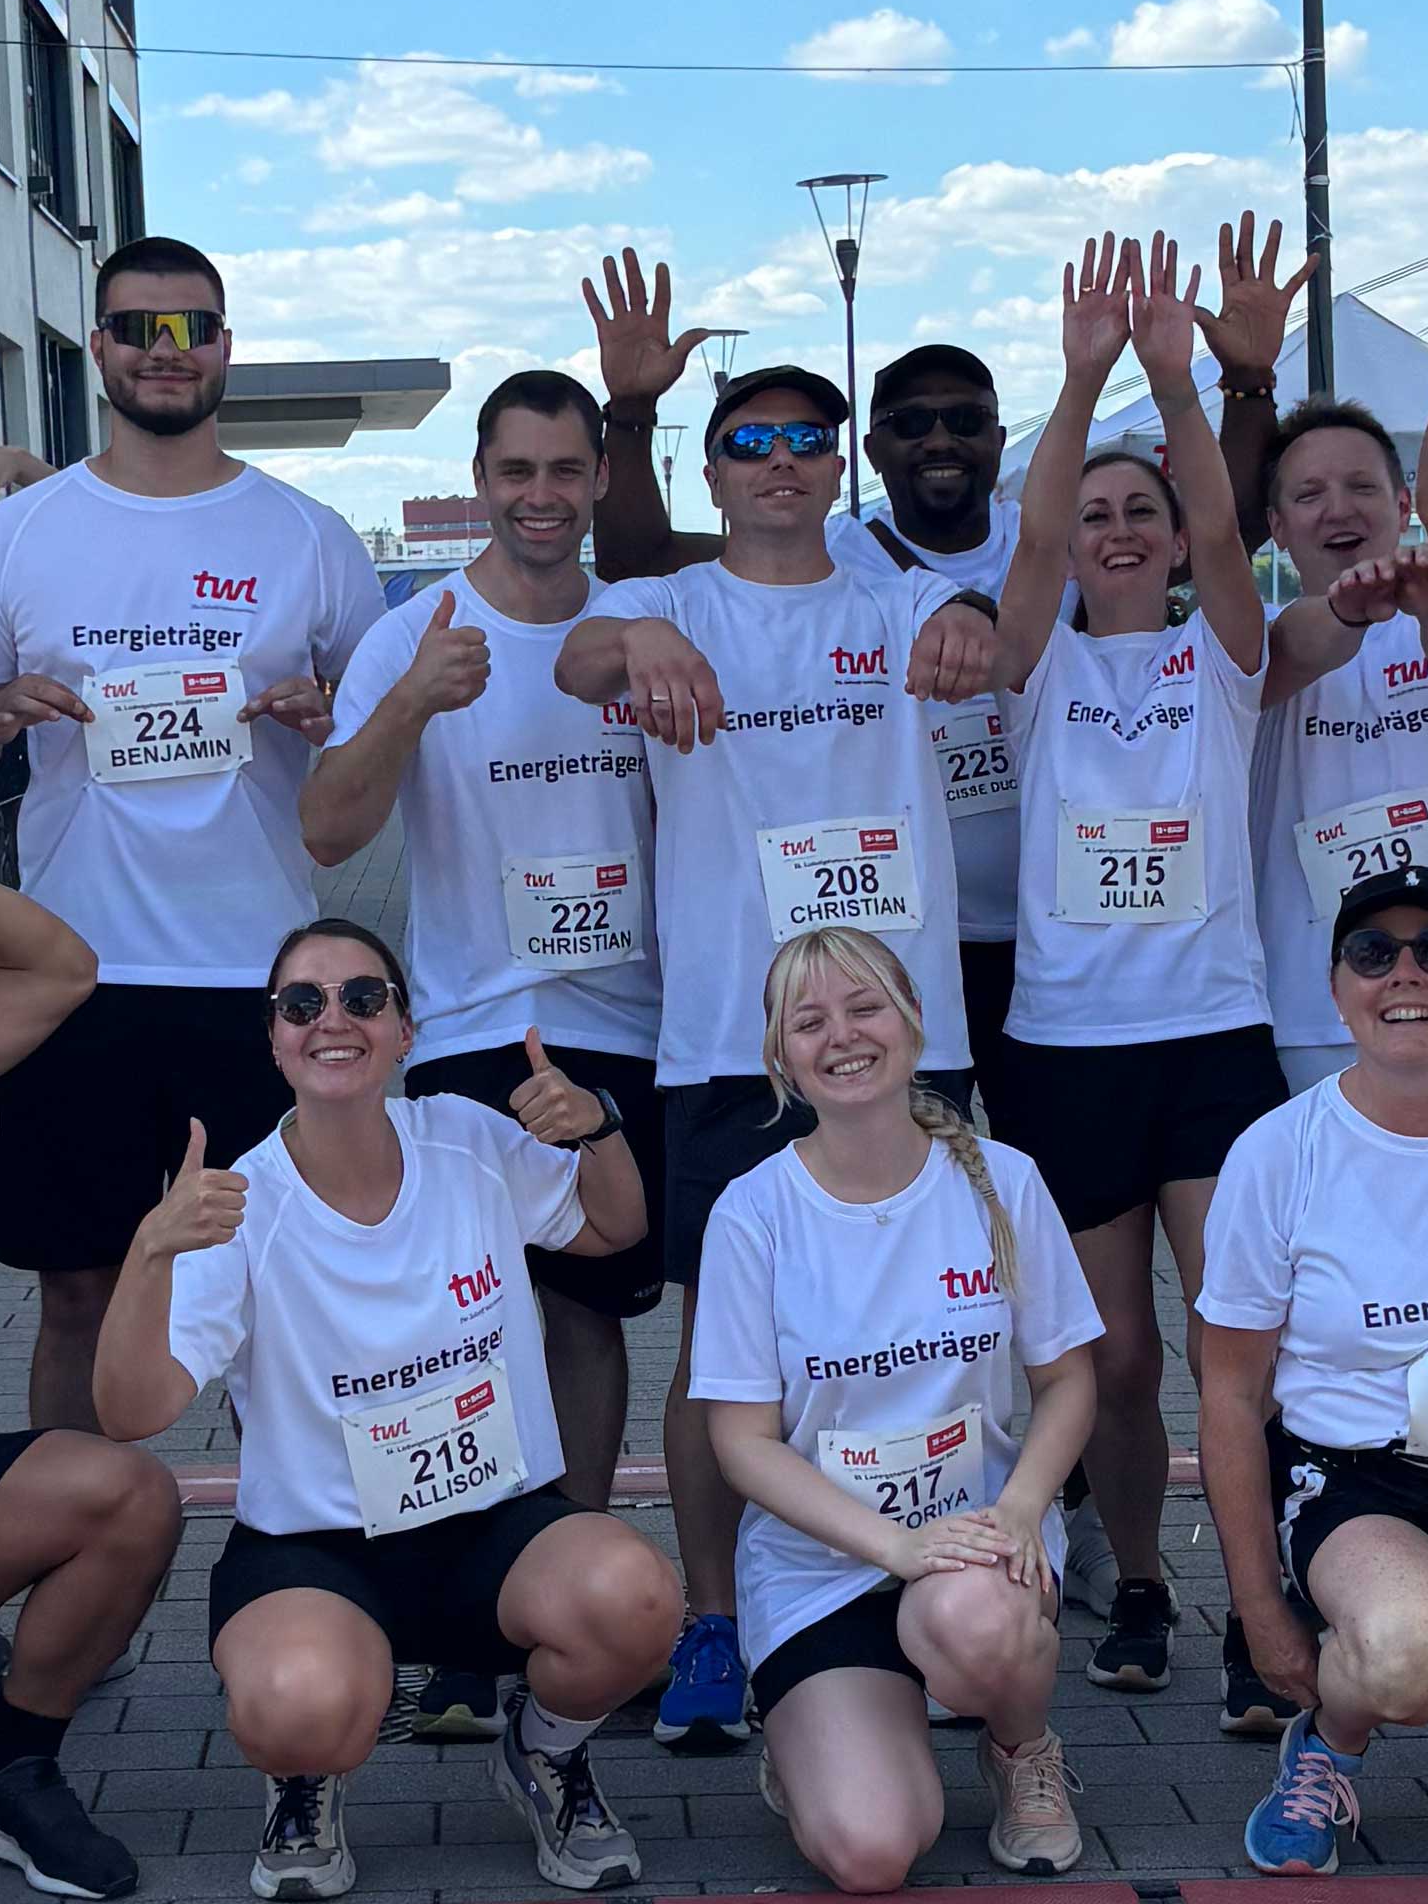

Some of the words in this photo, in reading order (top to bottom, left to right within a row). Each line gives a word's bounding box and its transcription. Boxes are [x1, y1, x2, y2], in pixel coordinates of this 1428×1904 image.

[193, 570, 258, 604] twl
[72, 622, 243, 652] Energieträger
[829, 644, 888, 675] twl
[101, 679, 139, 698] twl
[134, 707, 203, 743] 224
[602, 701, 638, 726] tw
[111, 739, 231, 767] BENJAMIN
[489, 749, 645, 783] Energieträger
[948, 746, 1009, 783] 225
[780, 836, 817, 857] twl
[1316, 822, 1347, 844] twl
[1099, 855, 1165, 887] 215
[1348, 838, 1412, 880] 219
[814, 863, 880, 899] 208
[790, 896, 907, 925] CHRISTIAN
[1100, 890, 1165, 909] JULIA
[551, 899, 610, 934] 222
[528, 931, 632, 955] CHRISTIAN
[448, 1253, 501, 1308] twl
[332, 1325, 503, 1398] Energieträger
[805, 1331, 1001, 1381] Energieträger
[369, 1416, 411, 1442] twl
[409, 1431, 479, 1485] 218
[840, 1447, 880, 1466] twl
[399, 1456, 498, 1514] ALLISON
[876, 1465, 942, 1516] 217
